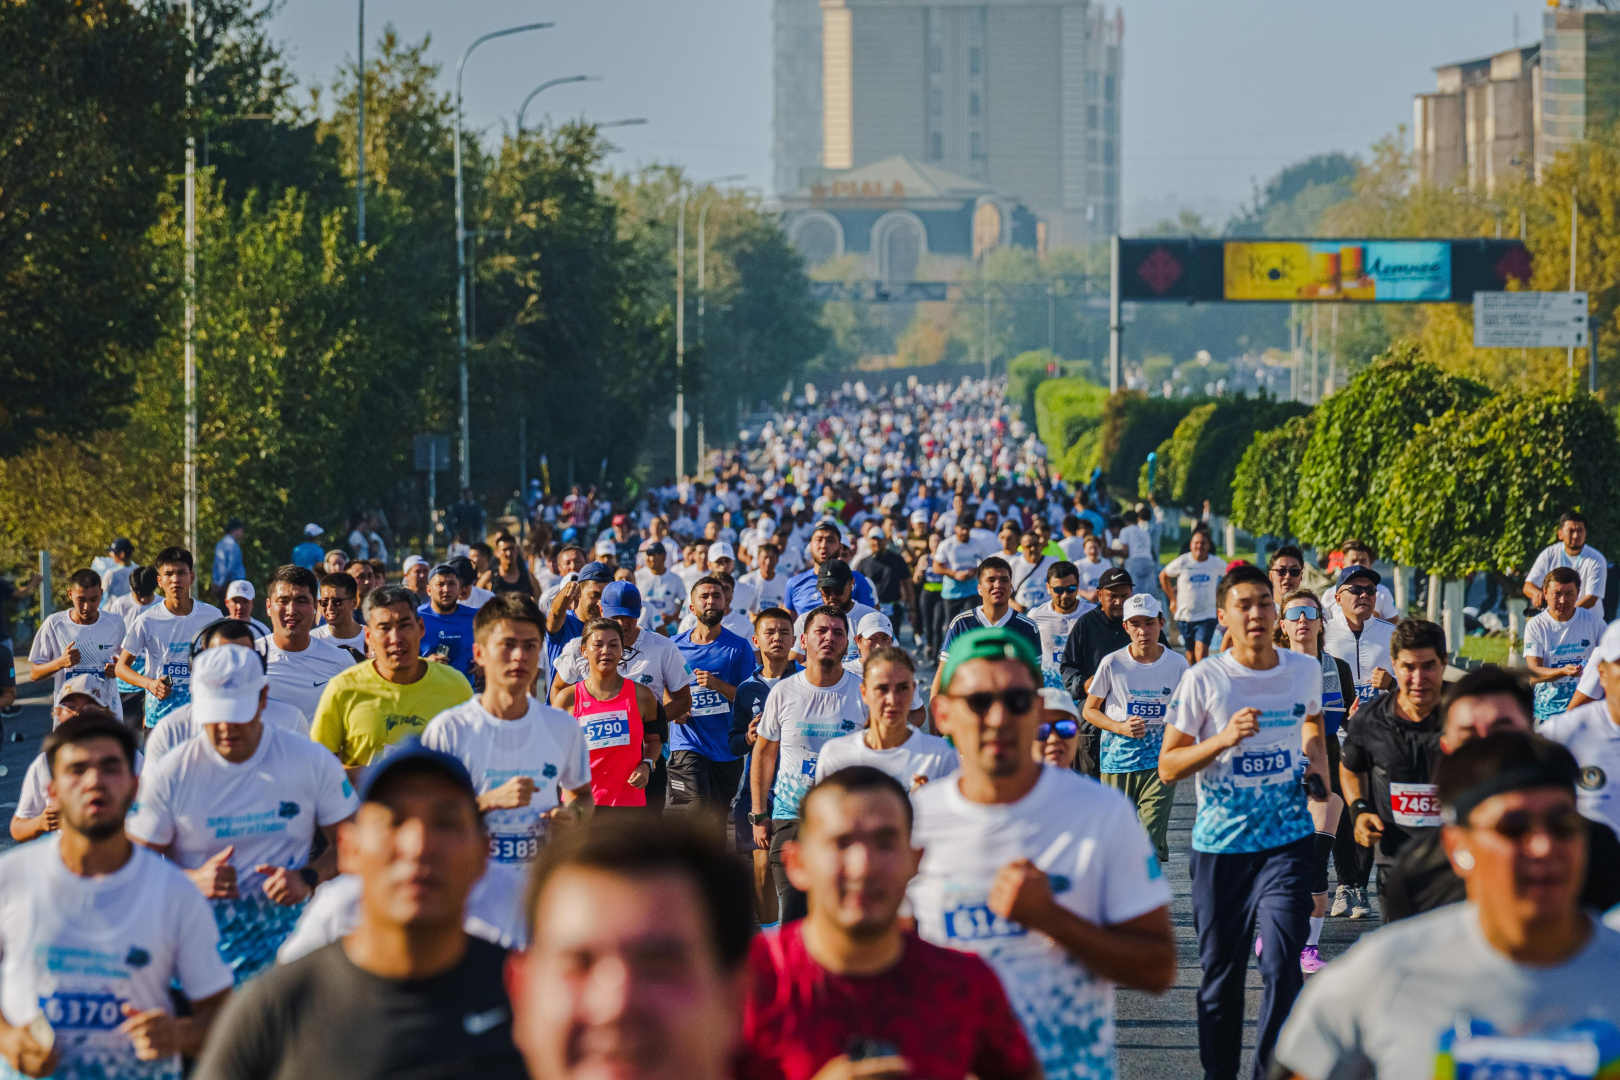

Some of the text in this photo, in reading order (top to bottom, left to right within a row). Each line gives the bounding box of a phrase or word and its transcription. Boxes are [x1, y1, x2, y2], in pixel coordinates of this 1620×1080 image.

[168, 665, 190, 675] 668
[1355, 687, 1375, 697] 342
[692, 692, 722, 706] 5551
[1132, 704, 1161, 716] 6553
[586, 721, 623, 738] 5790
[795, 721, 840, 731] Shymkent
[801, 728, 847, 738] Marathon
[1242, 754, 1286, 774] 6878
[1398, 796, 1442, 812] 7462
[490, 839, 538, 858] 5383
